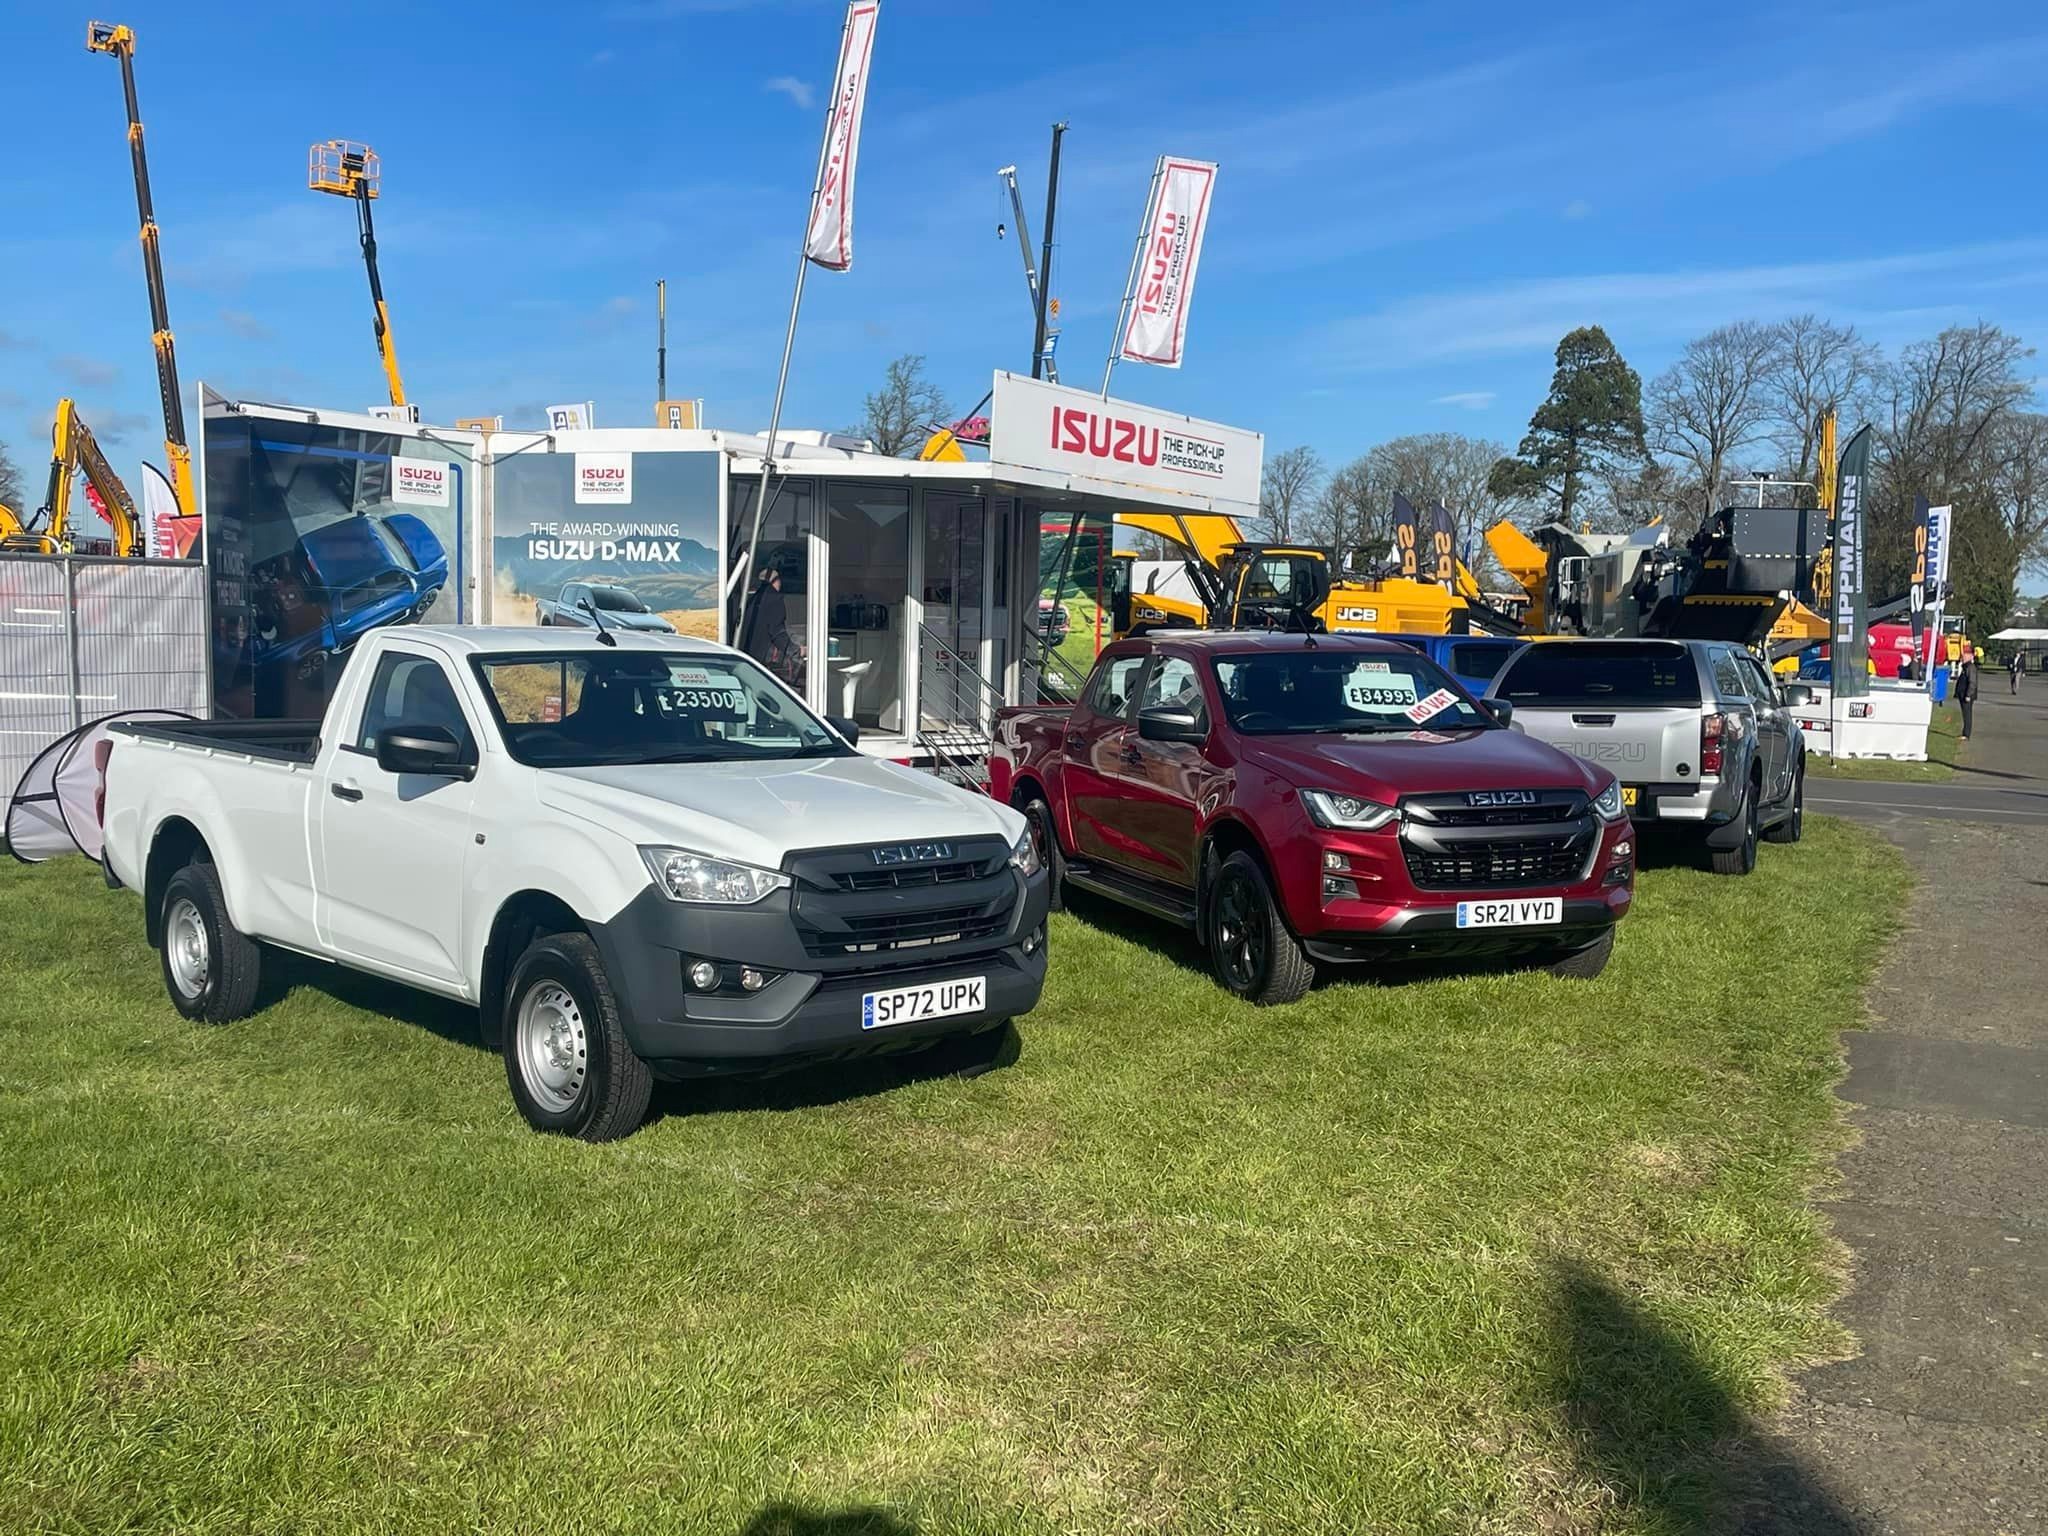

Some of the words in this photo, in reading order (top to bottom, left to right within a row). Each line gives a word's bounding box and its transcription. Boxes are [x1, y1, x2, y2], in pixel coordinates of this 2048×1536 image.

[1142, 212, 1176, 314] ISUZU
[1161, 285, 1173, 315] THE
[1170, 215, 1186, 278] PICK-UP
[1052, 406, 1159, 467] ISUZU
[1163, 436, 1183, 453] THE
[1187, 441, 1225, 460] PICK-UP
[400, 467, 442, 481] ISUZU
[582, 468, 625, 479] ISUZU
[1161, 453, 1224, 474] PROFESSIONALS
[530, 522, 558, 536] THE
[561, 522, 680, 537] AWARD-WINNING
[528, 540, 594, 561] ISUZU
[601, 541, 681, 563] D-MAX
[1837, 475, 1857, 643] LIPPMANN
[1136, 609, 1165, 621] JCB
[1337, 608, 1377, 622] JCB
[936, 650, 976, 660] ISZU
[1409, 704, 1432, 721] NO
[1428, 690, 1453, 710] VAT
[1468, 791, 1537, 806] ISUZU
[873, 843, 952, 865] ISUZU
[1474, 903, 1515, 924] SR21
[1520, 902, 1555, 921] VYD
[878, 989, 934, 1022] SP72
[940, 982, 981, 1011] UPK
